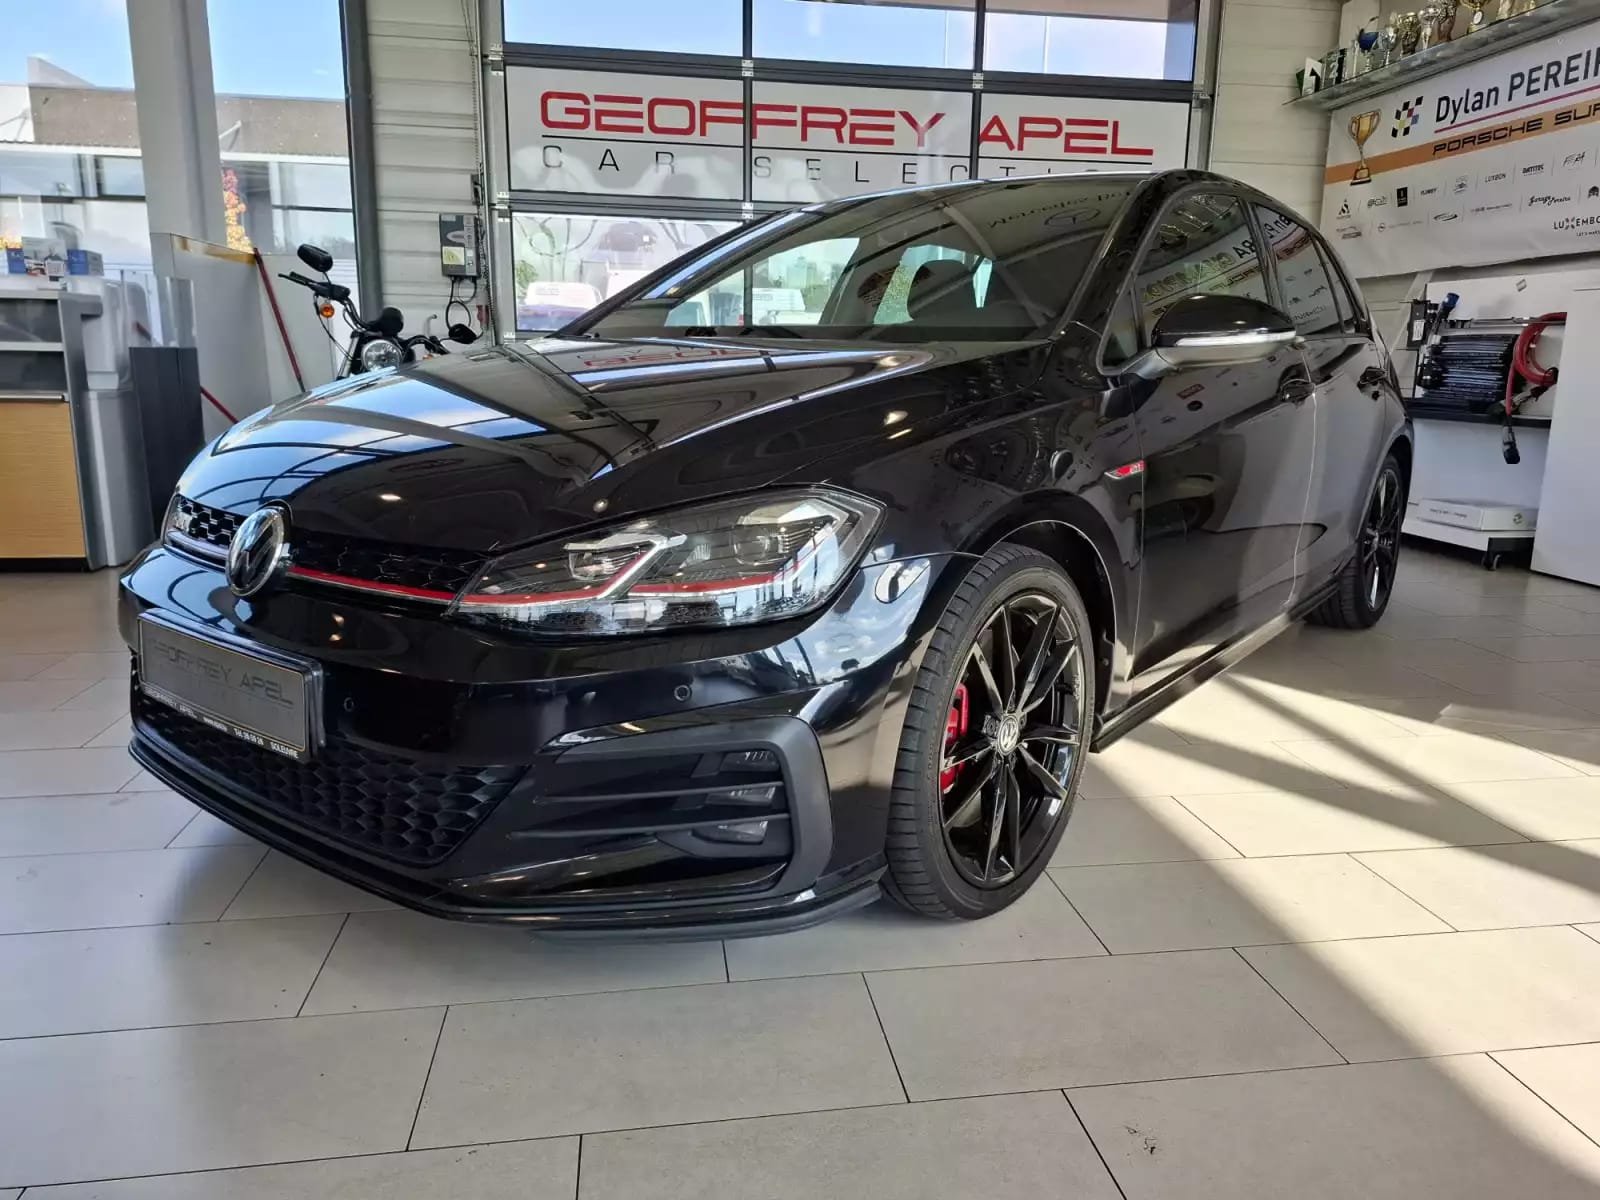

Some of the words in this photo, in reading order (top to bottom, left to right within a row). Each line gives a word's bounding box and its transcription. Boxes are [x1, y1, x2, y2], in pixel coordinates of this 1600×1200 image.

[540, 91, 946, 147] GEOFFREY
[979, 114, 1153, 155] APEL
[1436, 86, 1499, 124] Dylan
[1432, 118, 1543, 156] PORSCHE
[542, 145, 675, 175] CAR
